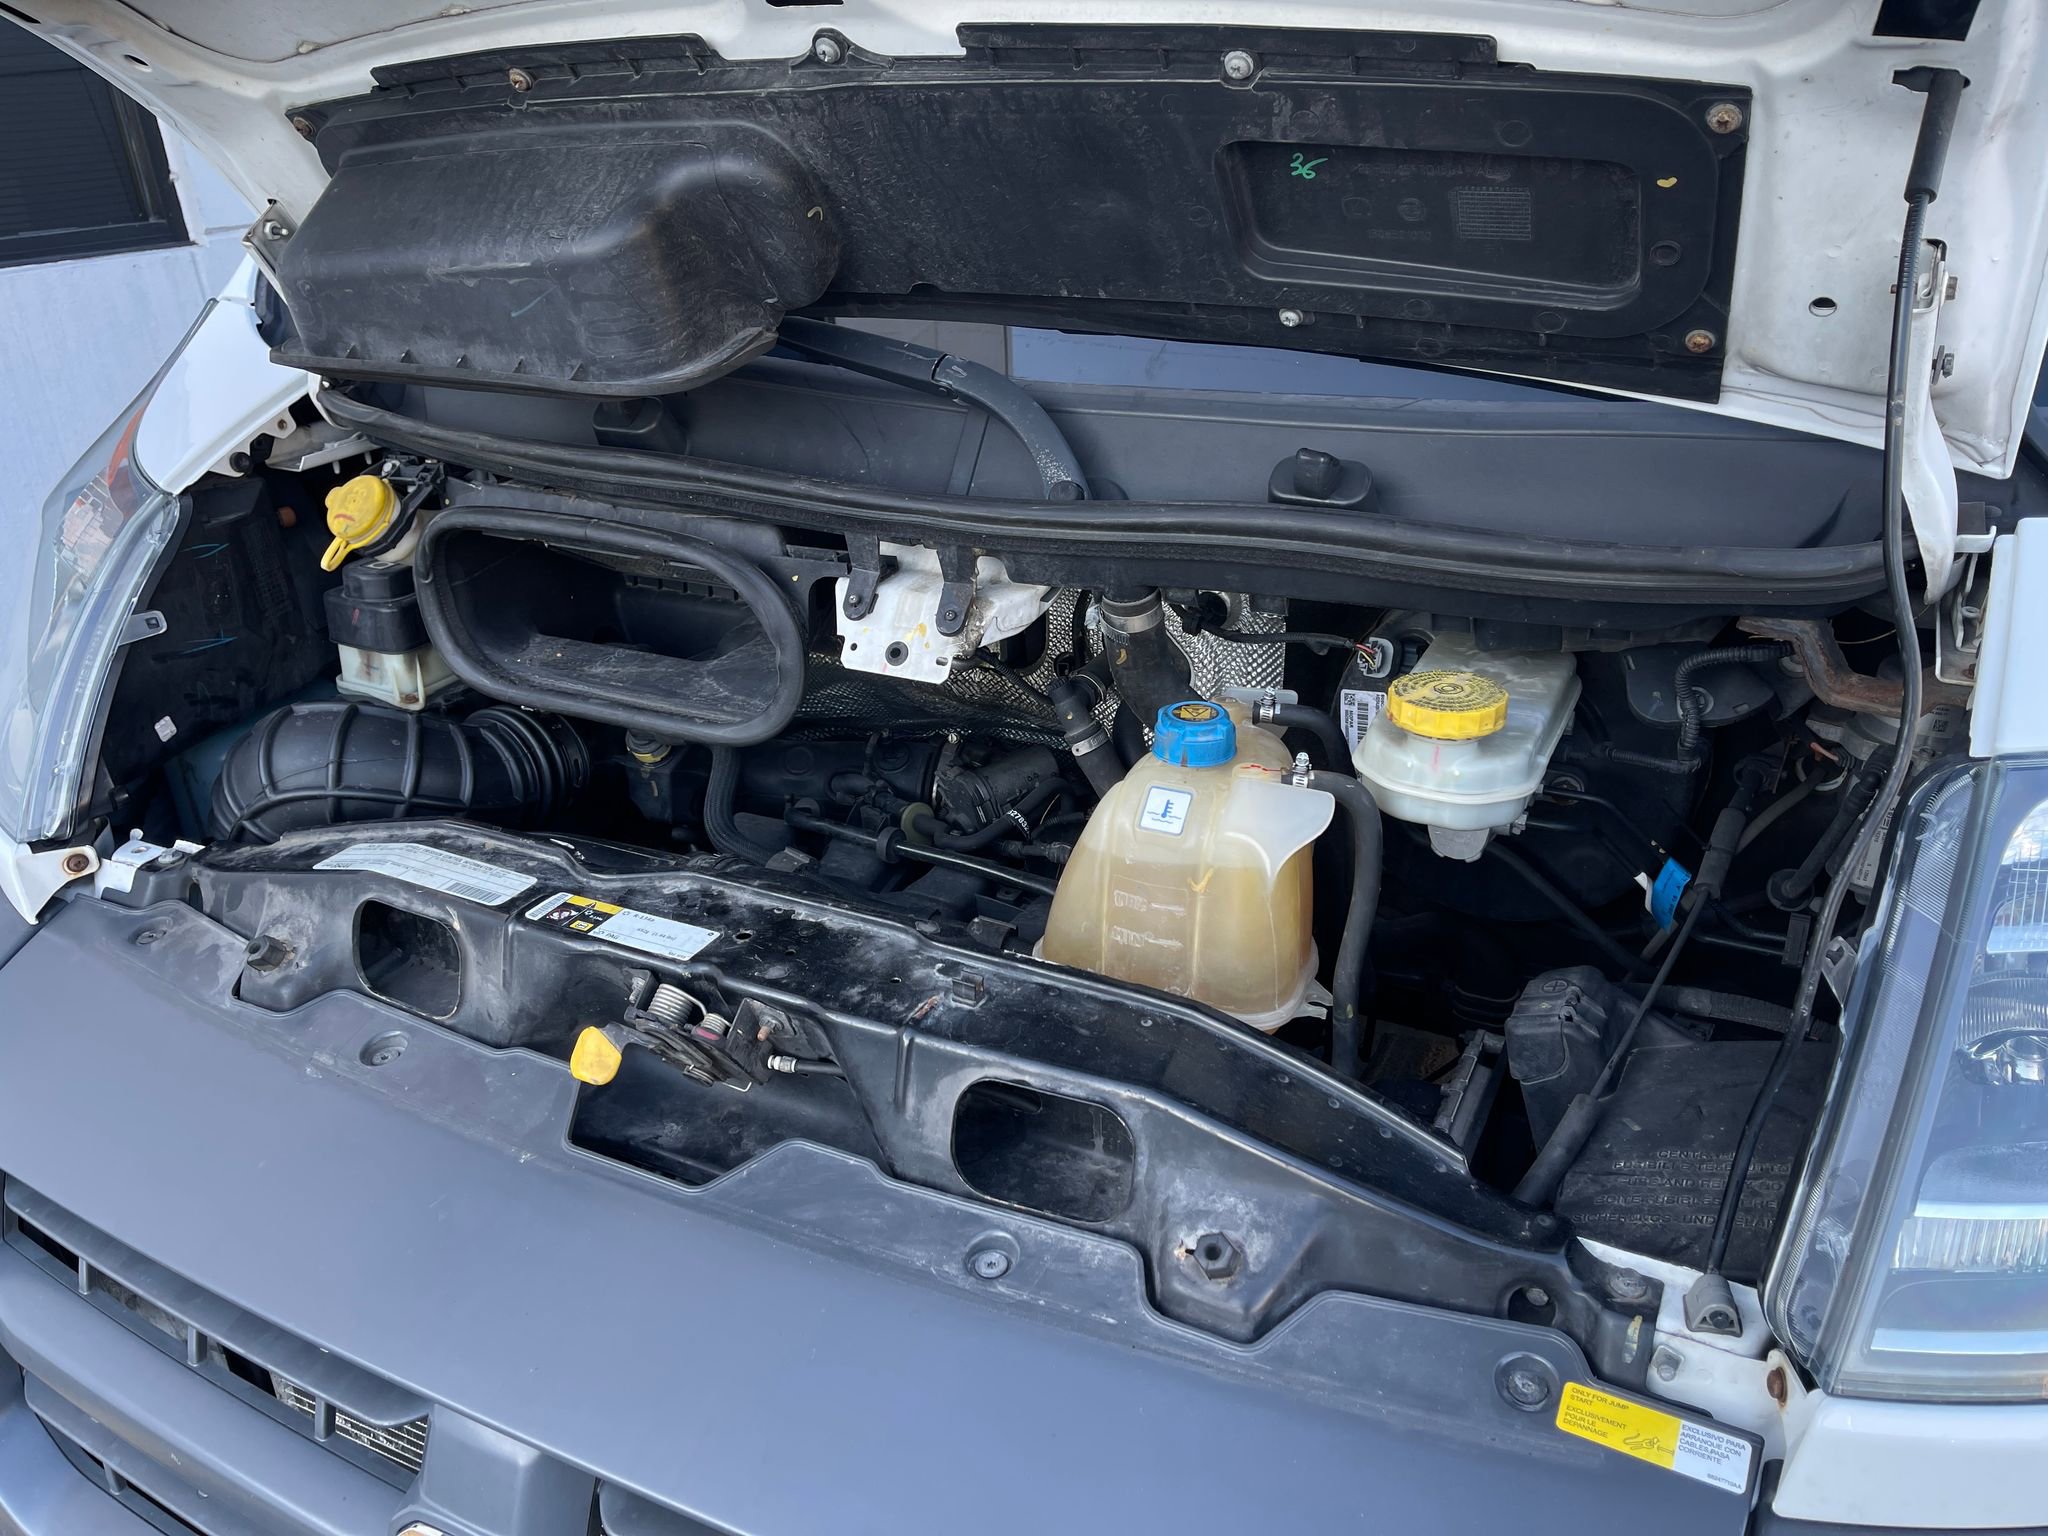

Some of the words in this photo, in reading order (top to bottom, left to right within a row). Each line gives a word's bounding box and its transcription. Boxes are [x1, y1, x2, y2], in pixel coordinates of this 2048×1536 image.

[1290, 152, 1329, 179] 36
[1570, 1394, 1593, 1406] START
[1572, 1387, 1591, 1398] ONLY
[1592, 1394, 1607, 1404] FOR
[1609, 1401, 1629, 1410] JUMP
[1565, 1411, 1586, 1423] POUR
[1587, 1419, 1597, 1427] LE
[1566, 1404, 1627, 1430] EXCLUSIVEMENT
[1681, 1432, 1723, 1451] ARRANQUE
[1724, 1446, 1742, 1457] CON
[1682, 1424, 1725, 1443] EXCLUSIVO
[1725, 1438, 1746, 1451] PARA
[1679, 1445, 1722, 1465] CORRIENTE
